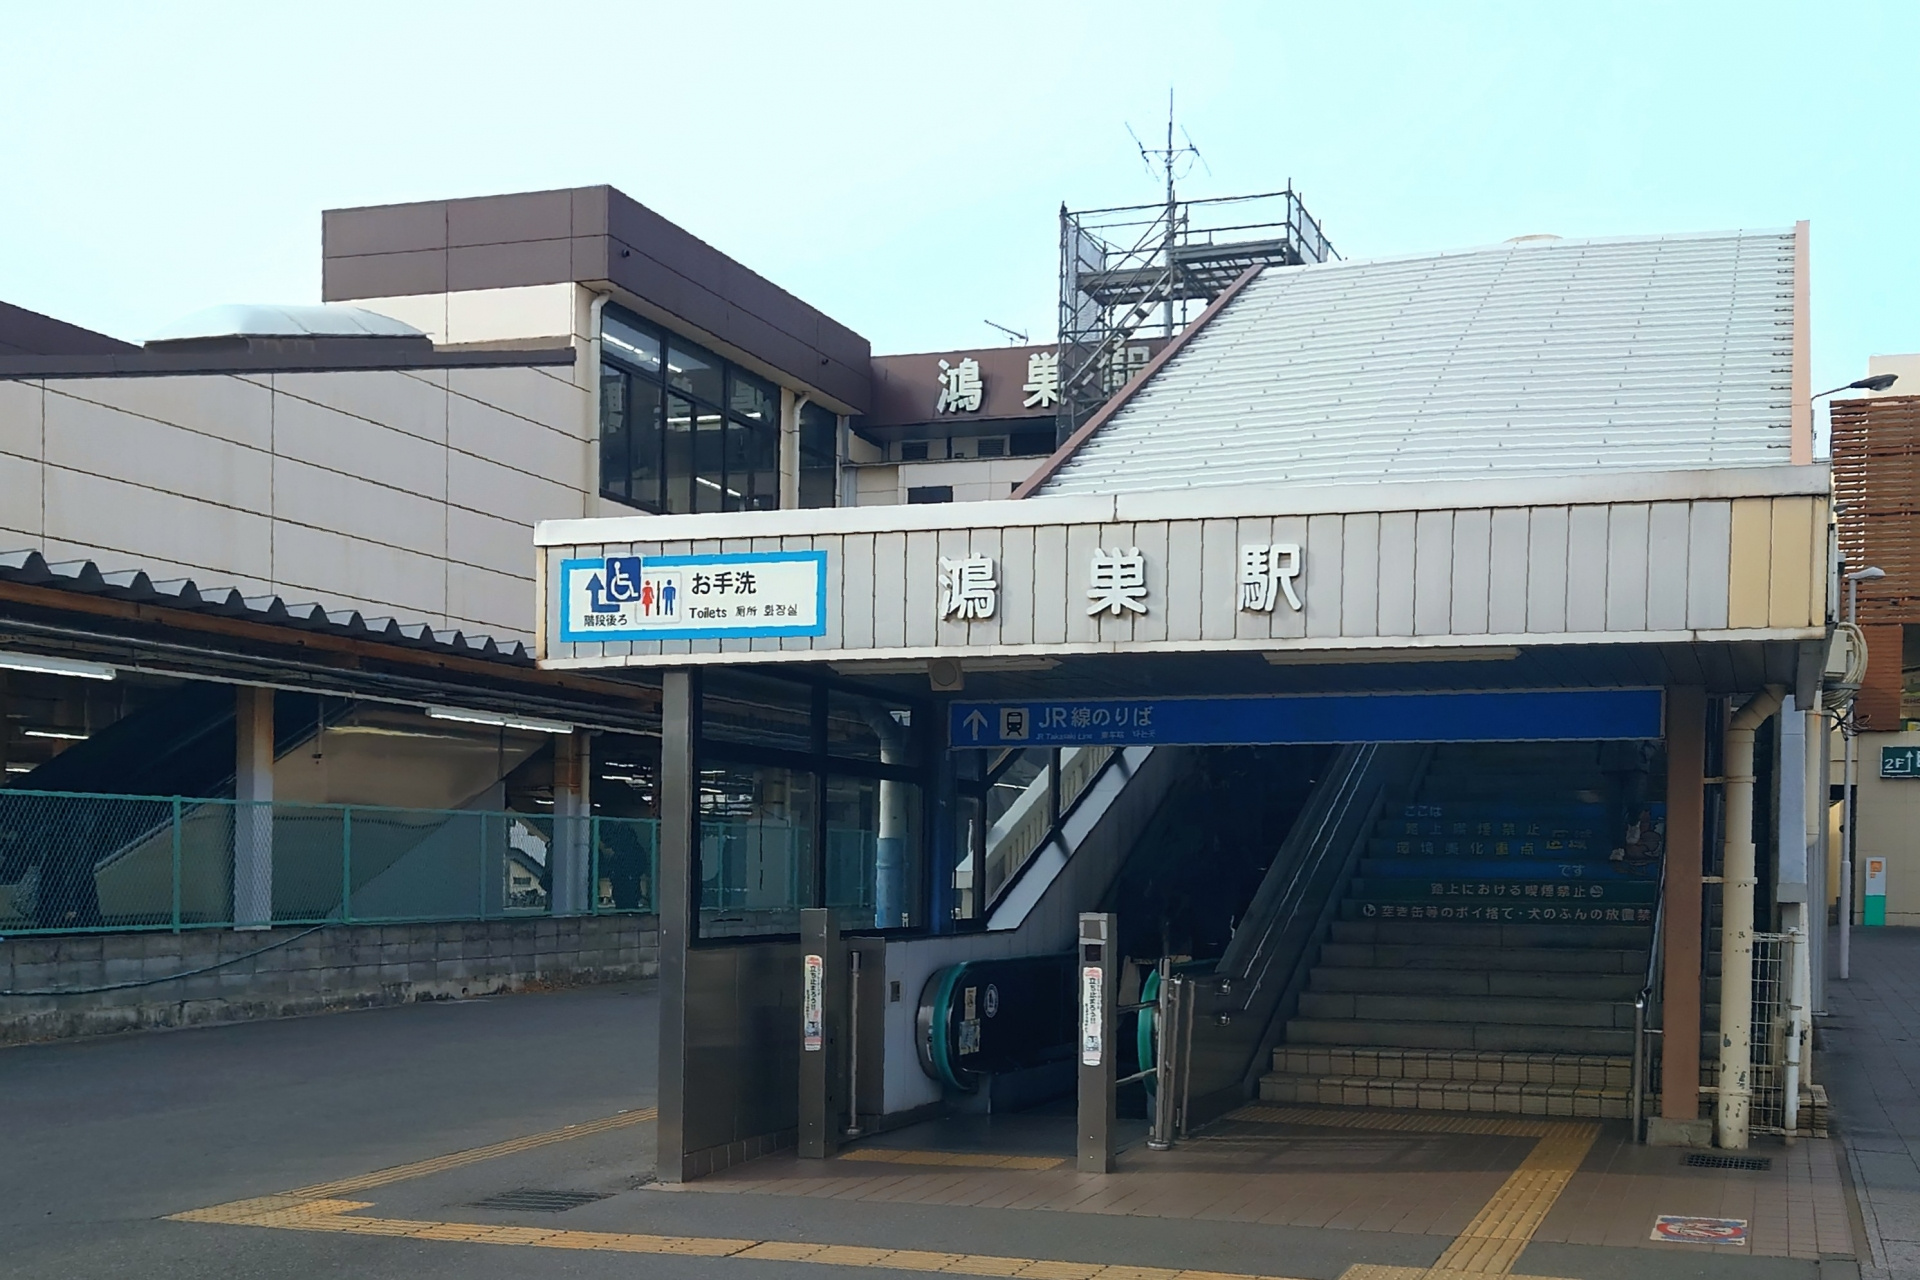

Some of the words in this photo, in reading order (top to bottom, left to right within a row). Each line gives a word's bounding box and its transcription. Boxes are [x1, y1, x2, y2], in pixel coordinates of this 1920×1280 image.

[691, 571, 757, 595] お手洗
[938, 543, 1303, 620] 鴻巣駅
[689, 606, 728, 619] Toilets
[763, 603, 798, 617] 화장실
[583, 613, 628, 627] 階段後ろ
[1038, 706, 1154, 728] JR線のりば
[1884, 758, 1906, 769] 2F
[1404, 805, 1442, 817] ここは
[1558, 864, 1586, 877] です
[1430, 882, 1587, 899] 路上における喫煙禁止
